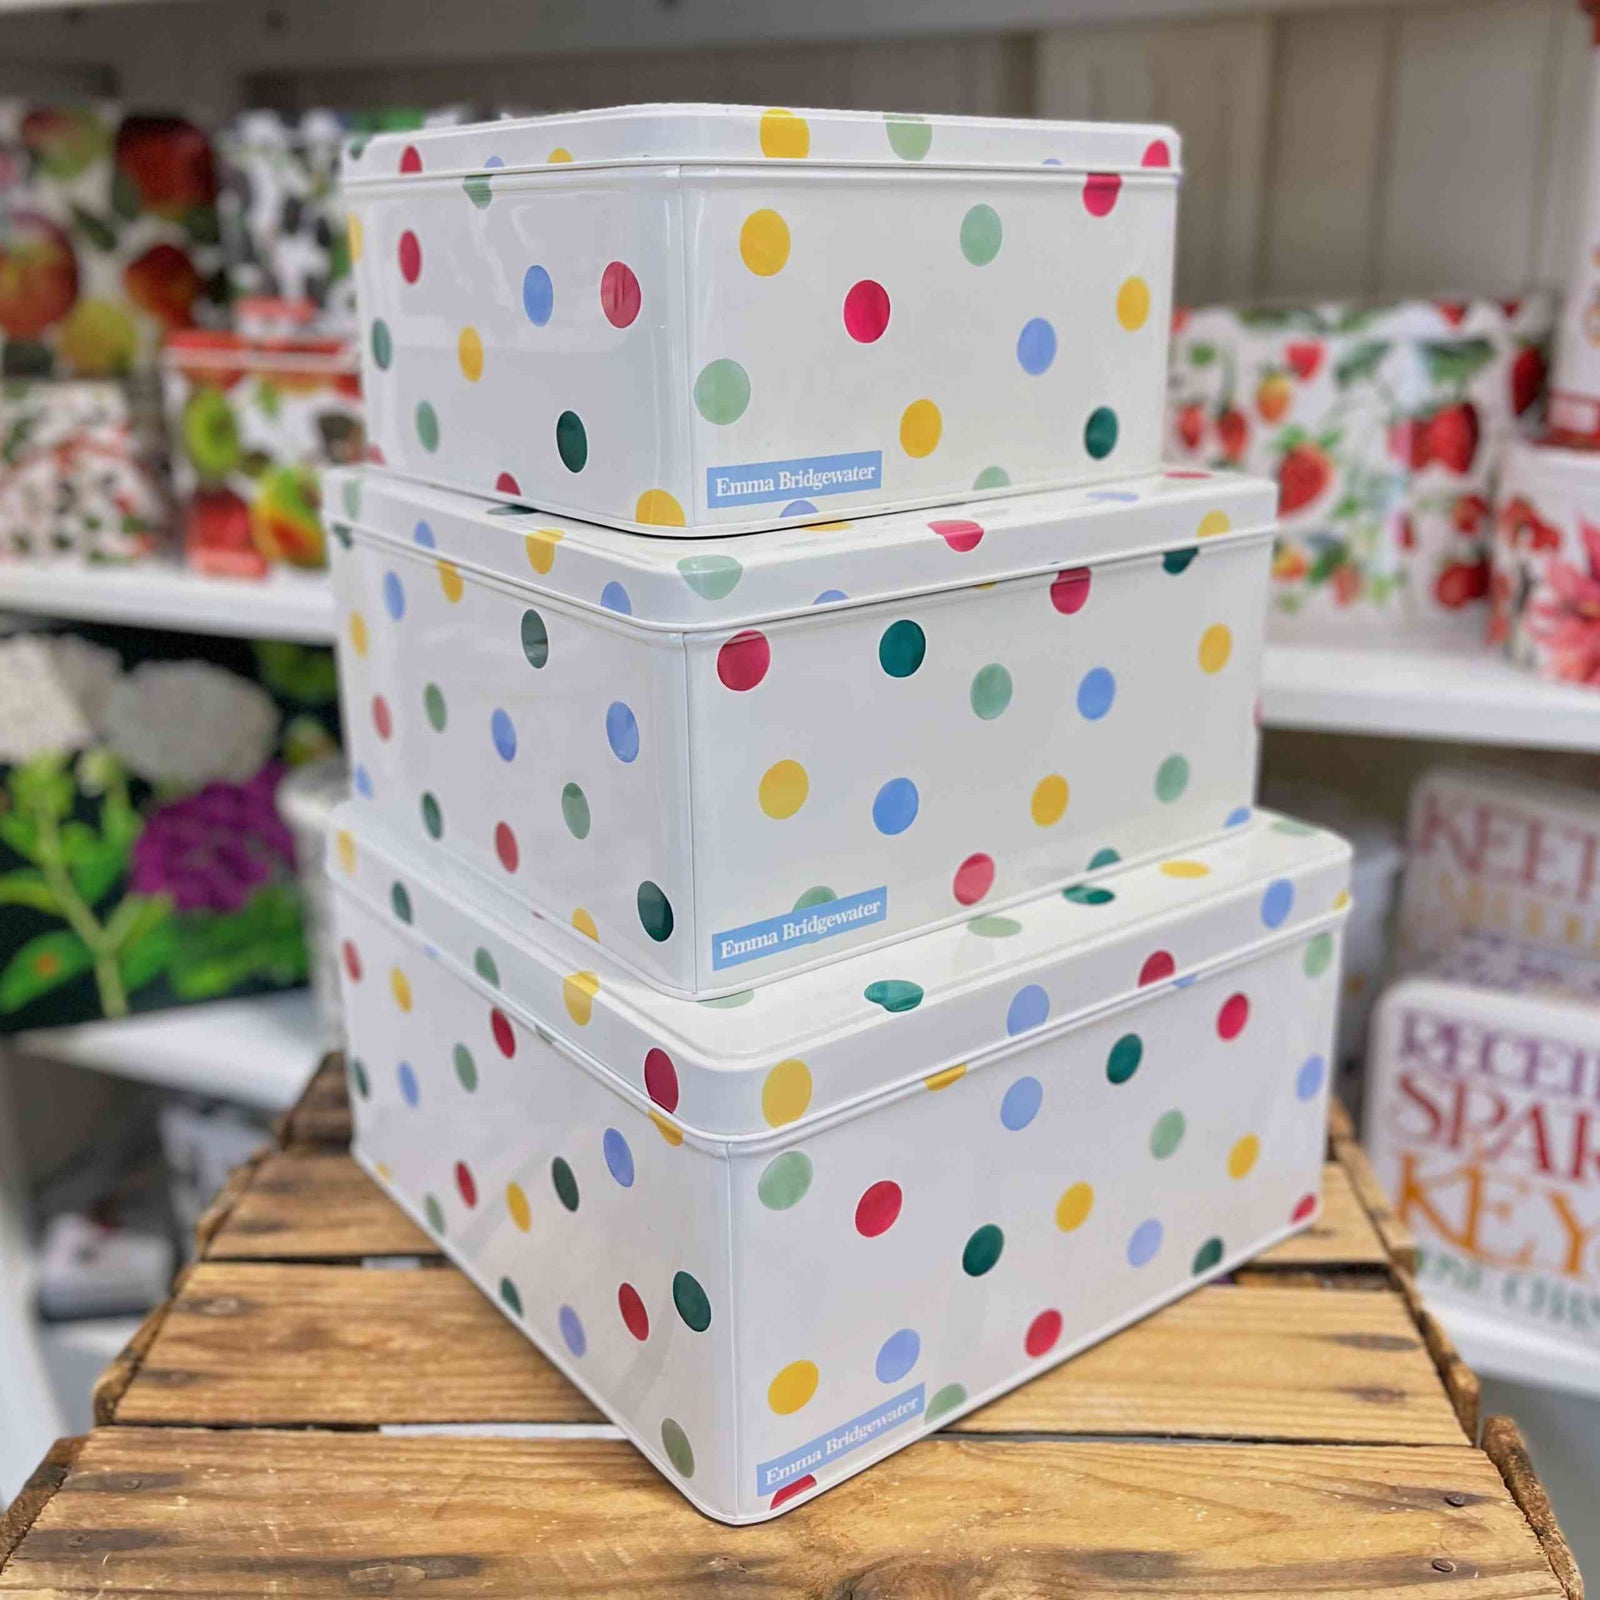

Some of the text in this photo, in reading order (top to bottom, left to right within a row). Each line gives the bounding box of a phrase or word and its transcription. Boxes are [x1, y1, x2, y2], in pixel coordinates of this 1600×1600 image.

[715, 465, 876, 498] Emma Bridgewater
[719, 900, 882, 961] Emma Bridgewater
[765, 1397, 920, 1487] Emma Bridgewater
